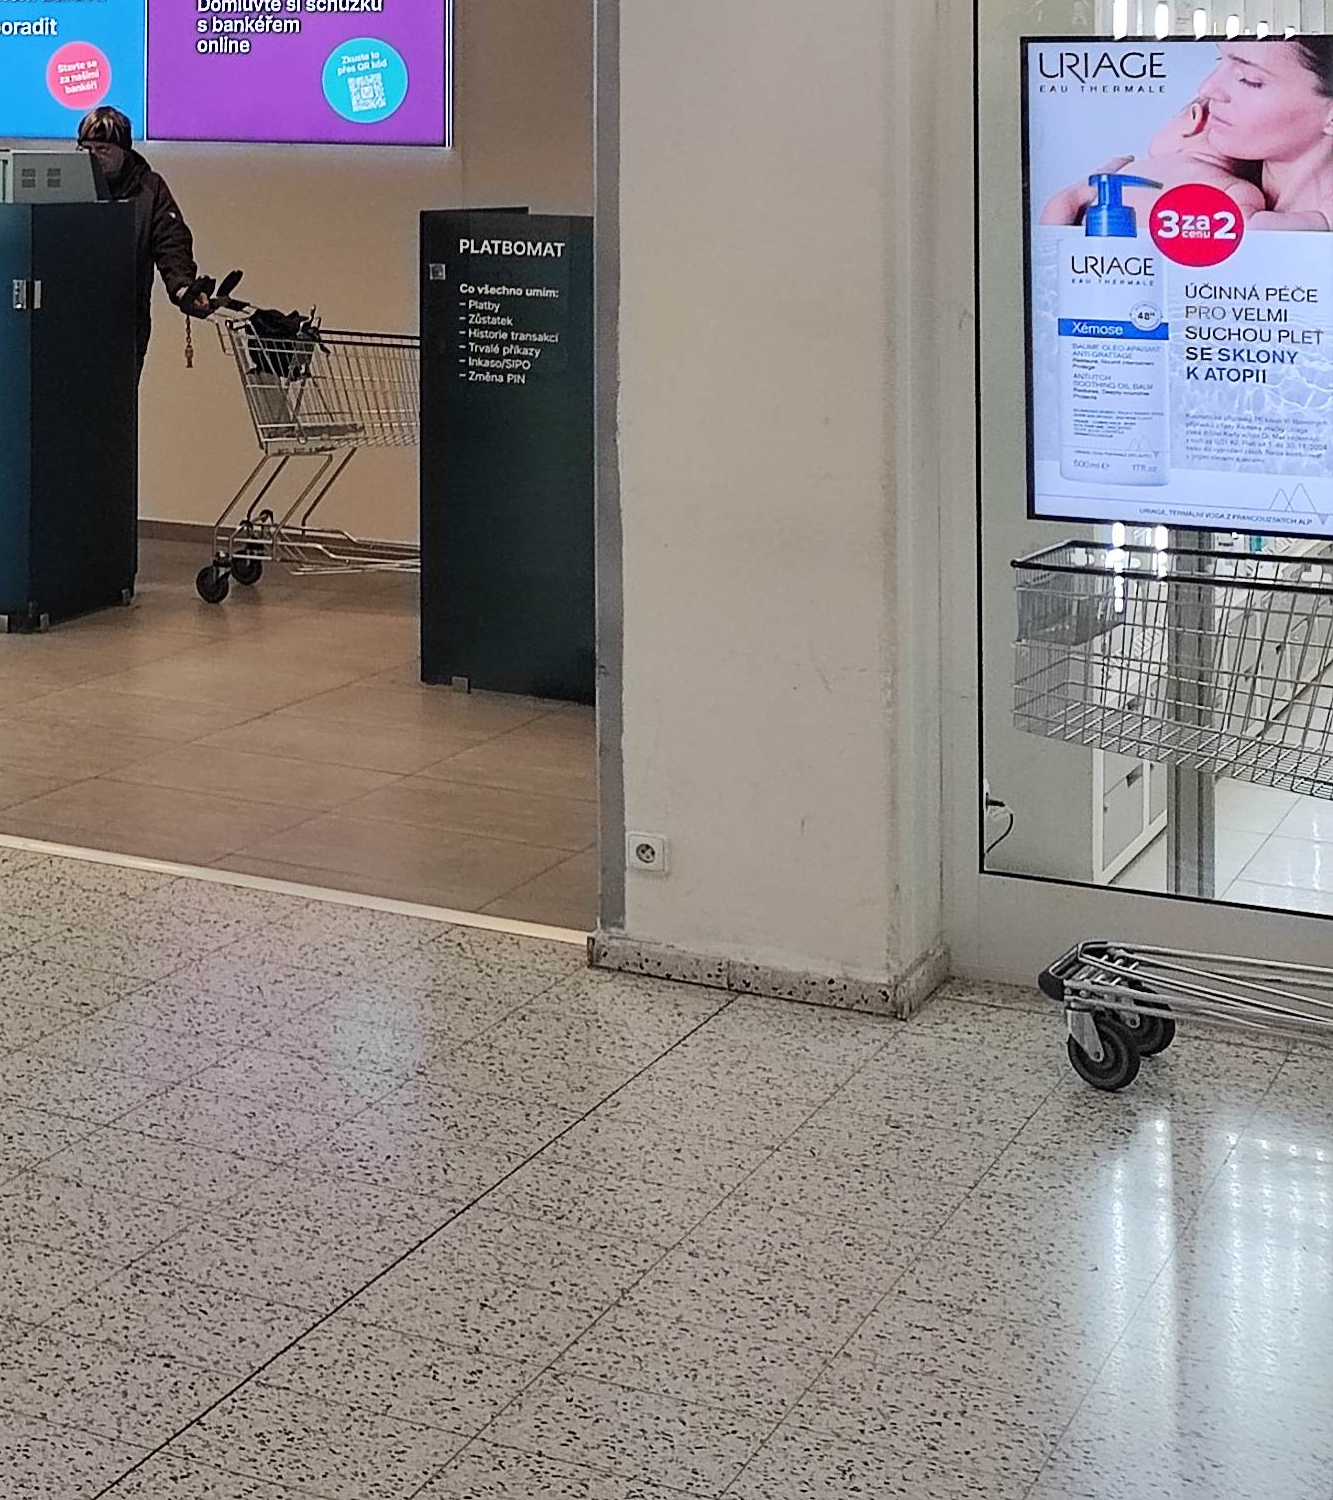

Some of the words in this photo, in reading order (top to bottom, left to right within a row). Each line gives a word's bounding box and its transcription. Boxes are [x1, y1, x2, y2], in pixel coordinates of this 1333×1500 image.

[197, 19, 208, 33] s
[211, 15, 300, 33] bankéřem
[197, 36, 251, 53] online
[1039, 52, 1167, 84] URIAGE
[1039, 85, 1068, 93] EAU
[1080, 85, 1166, 93] THERMALE
[1157, 209, 1180, 239] 3
[1181, 214, 1211, 230] za
[1213, 210, 1237, 240] 2
[1181, 230, 1211, 239] cenu
[459, 238, 566, 258] PLATBOMAT
[1071, 255, 1155, 278] URIAGE
[459, 283, 475, 294] Co
[476, 284, 523, 297] všechno
[524, 287, 560, 298] umím:
[1185, 282, 1261, 301] ÚČINNÁ
[1265, 285, 1318, 303] PÉČE
[468, 299, 501, 313] Platby
[1185, 305, 1227, 320] PRO
[1231, 307, 1288, 322] VELMI
[468, 312, 513, 327] Zůstatek
[1071, 321, 1124, 335] Xémose
[468, 327, 508, 340] Historie
[510, 331, 560, 343] transakcí
[1185, 325, 1272, 342] SUCHOU
[468, 341, 500, 354] Trvalé
[502, 344, 542, 359] příkazy
[1185, 346, 1213, 361] SE
[1217, 347, 1299, 364] SKLONY
[468, 356, 532, 371] Inkaso/SIPO
[468, 370, 504, 383] Změna
[506, 373, 527, 385] PIN
[1186, 366, 1199, 380] K
[1204, 367, 1266, 384] ATOPII
